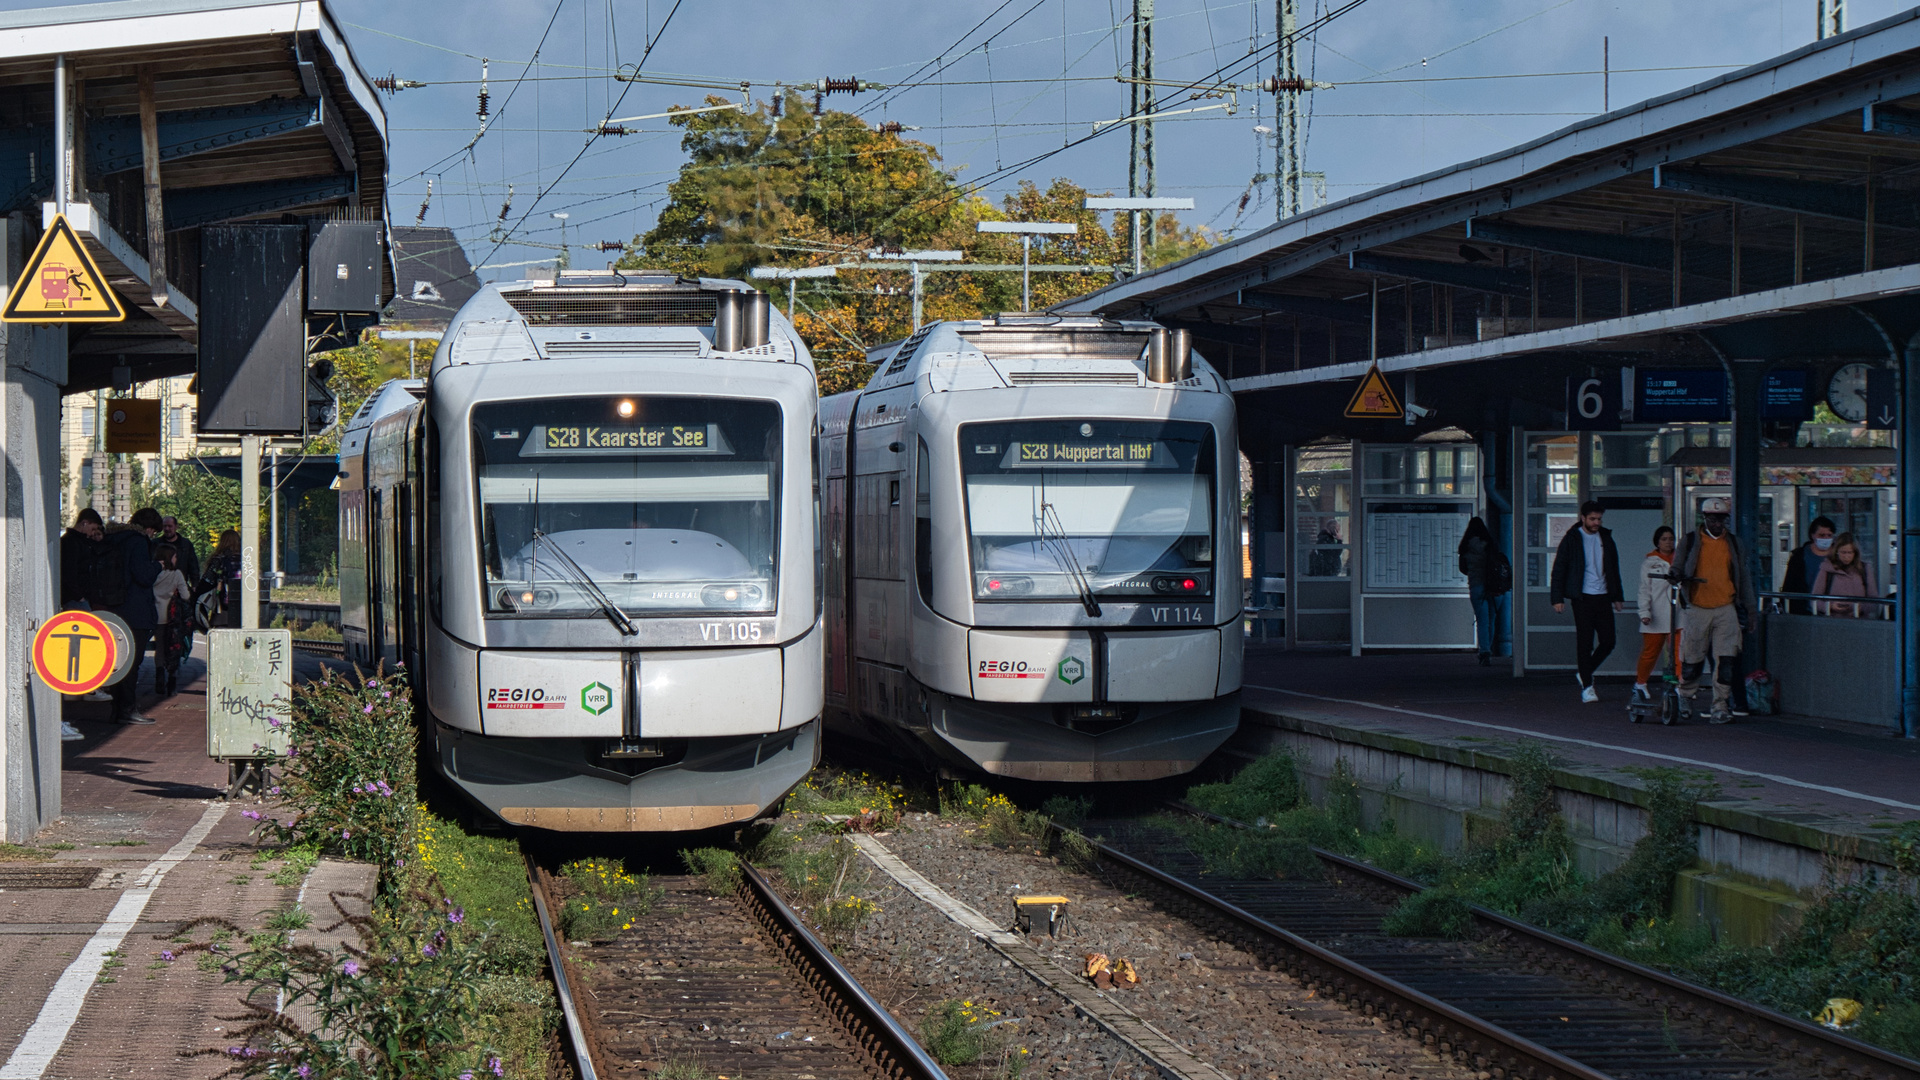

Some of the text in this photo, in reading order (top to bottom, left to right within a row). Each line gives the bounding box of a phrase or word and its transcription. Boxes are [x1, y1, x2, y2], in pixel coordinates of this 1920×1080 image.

[1577, 378, 1604, 419] 6
[1646, 387, 1676, 397] Wuppertal
[548, 425, 705, 448] S28 Kaarster See
[1022, 443, 1152, 463] S28 Wuppertal Hbf
[1151, 607, 1202, 623] VT 114
[699, 622, 762, 641] VT 105
[588, 694, 606, 703] VRR
